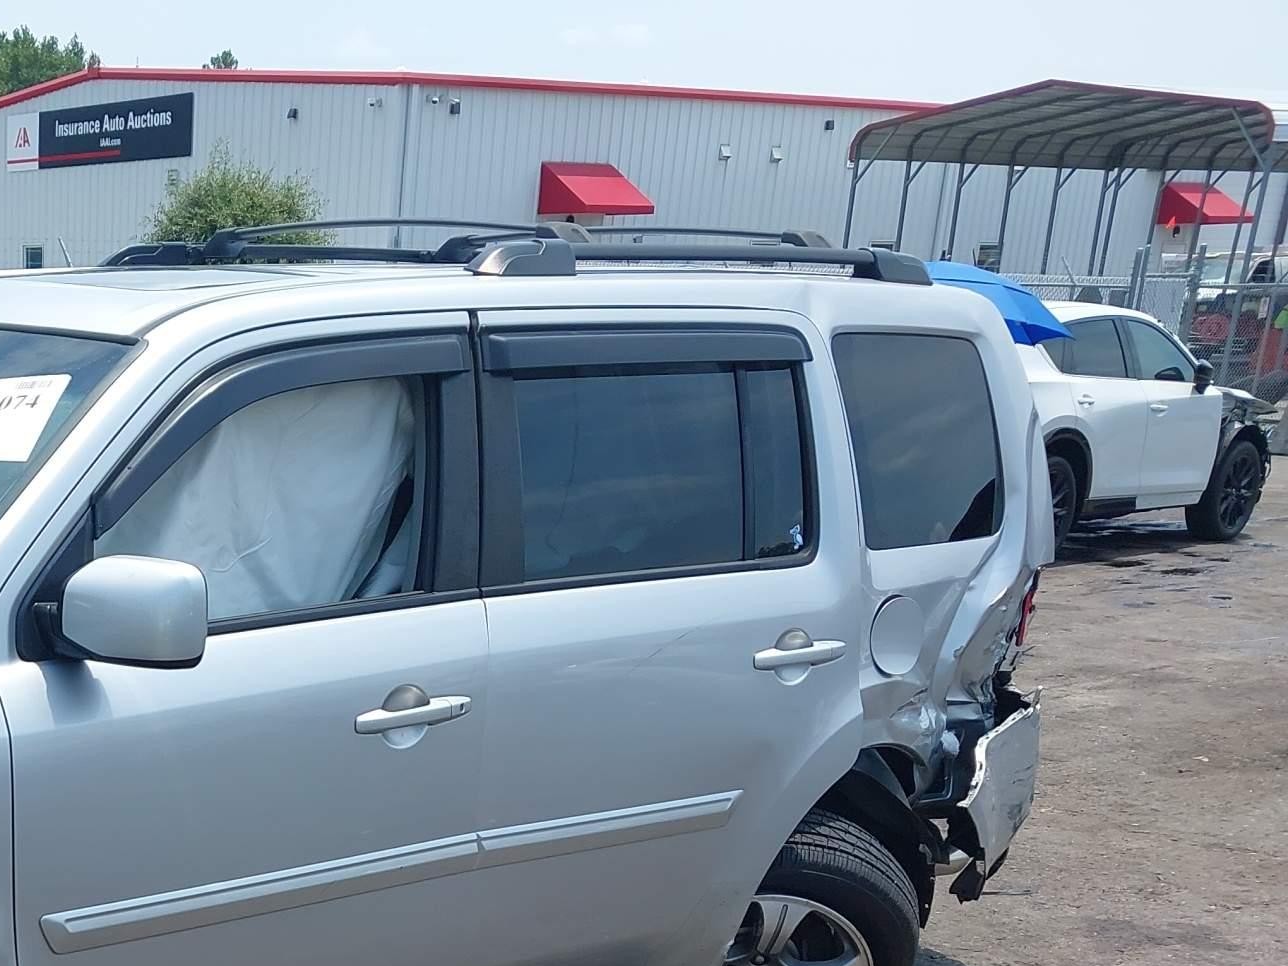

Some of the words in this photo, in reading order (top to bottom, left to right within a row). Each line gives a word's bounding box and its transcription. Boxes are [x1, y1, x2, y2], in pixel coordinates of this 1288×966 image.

[55, 119, 101, 137] Insurance
[103, 114, 125, 132] Auto
[127, 108, 172, 130] Auctions
